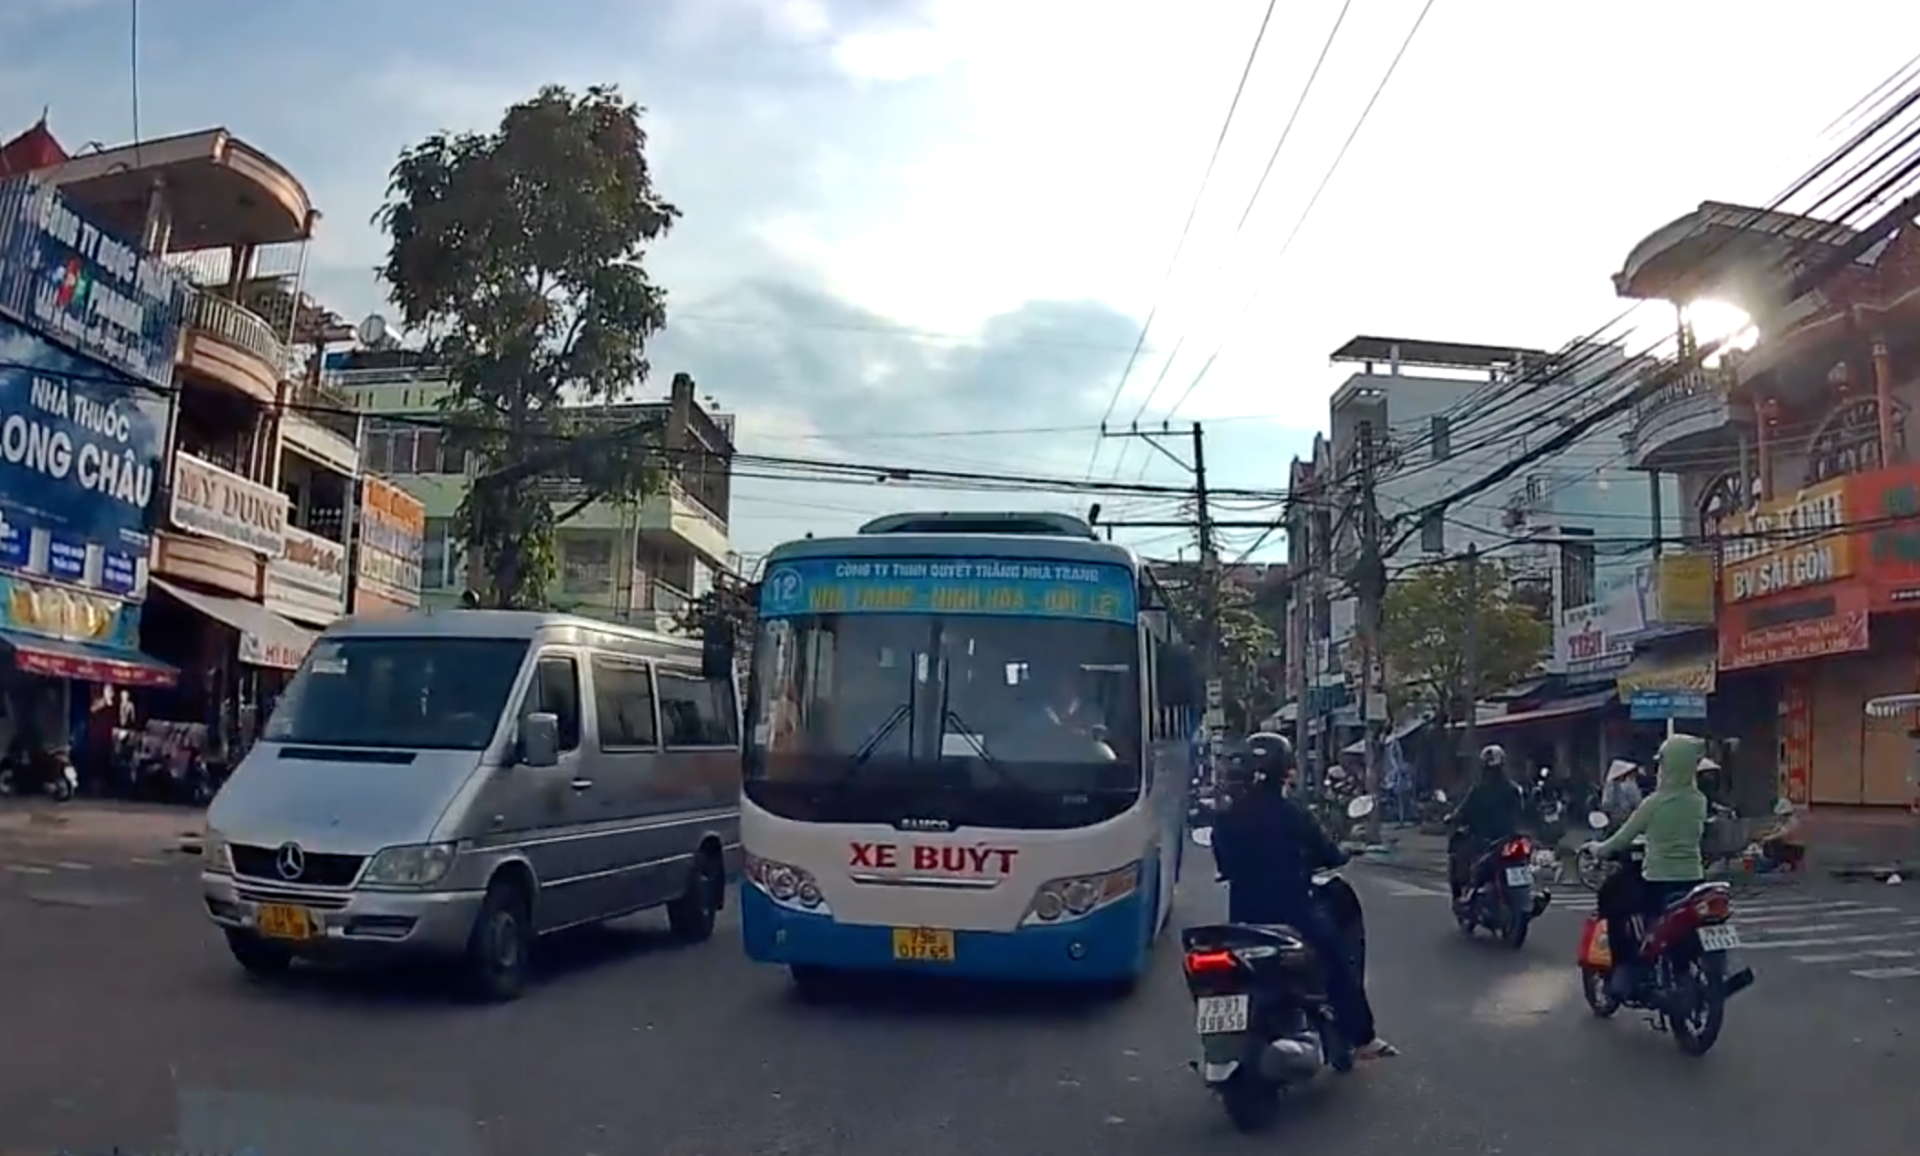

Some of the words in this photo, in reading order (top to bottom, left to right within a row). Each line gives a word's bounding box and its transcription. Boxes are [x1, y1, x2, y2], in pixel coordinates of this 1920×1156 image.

[31, 376, 69, 419] NHÀ
[73, 398, 130, 443] THUỐC
[0, 413, 72, 478] ONG
[78, 442, 153, 508] CHÂU
[874, 563, 889, 578] TY
[1733, 571, 1757, 598] BV
[772, 574, 798, 602] 12
[850, 842, 897, 869] XE
[913, 841, 1018, 874] BUÝT
